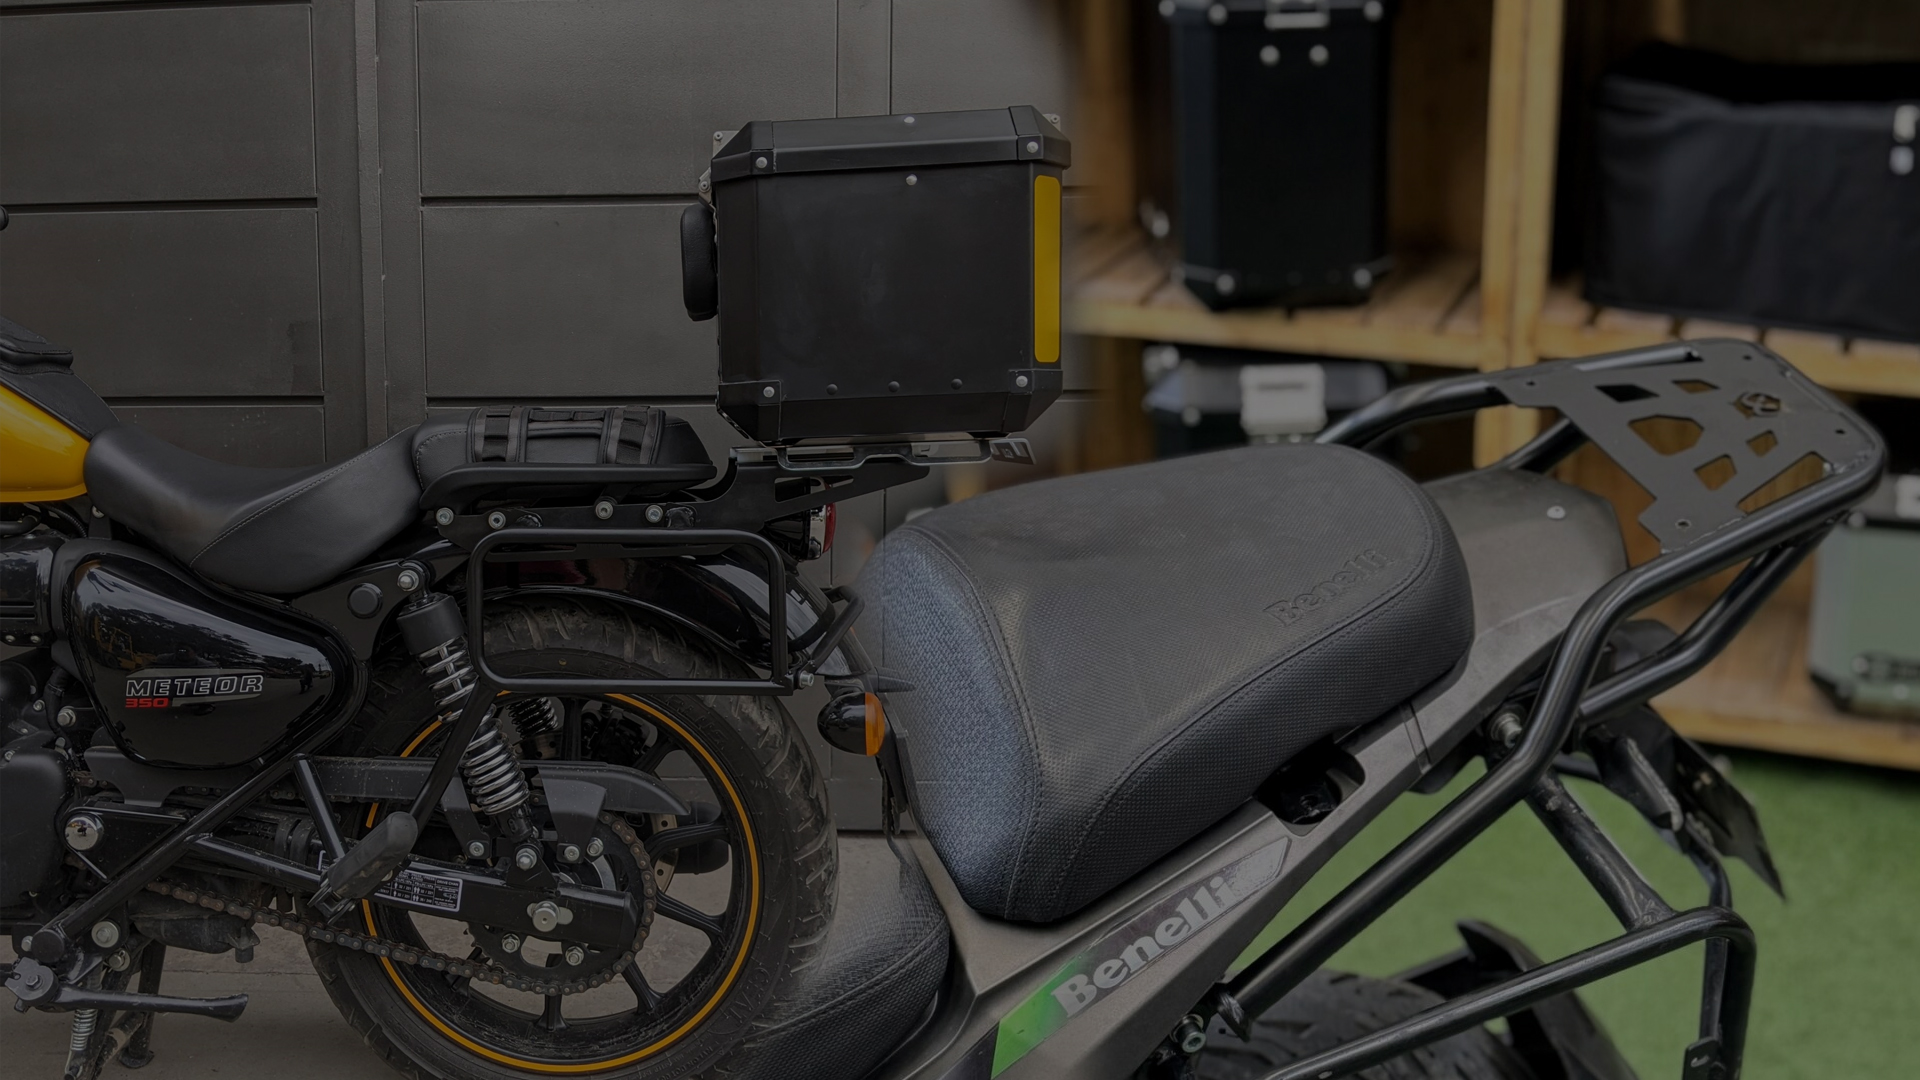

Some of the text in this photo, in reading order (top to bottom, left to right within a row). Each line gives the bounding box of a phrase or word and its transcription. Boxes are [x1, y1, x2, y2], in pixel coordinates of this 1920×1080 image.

[1263, 549, 1395, 627] Benelli
[125, 674, 264, 697] METEOR
[125, 697, 169, 708] 350
[1050, 876, 1243, 1019] Benelli
